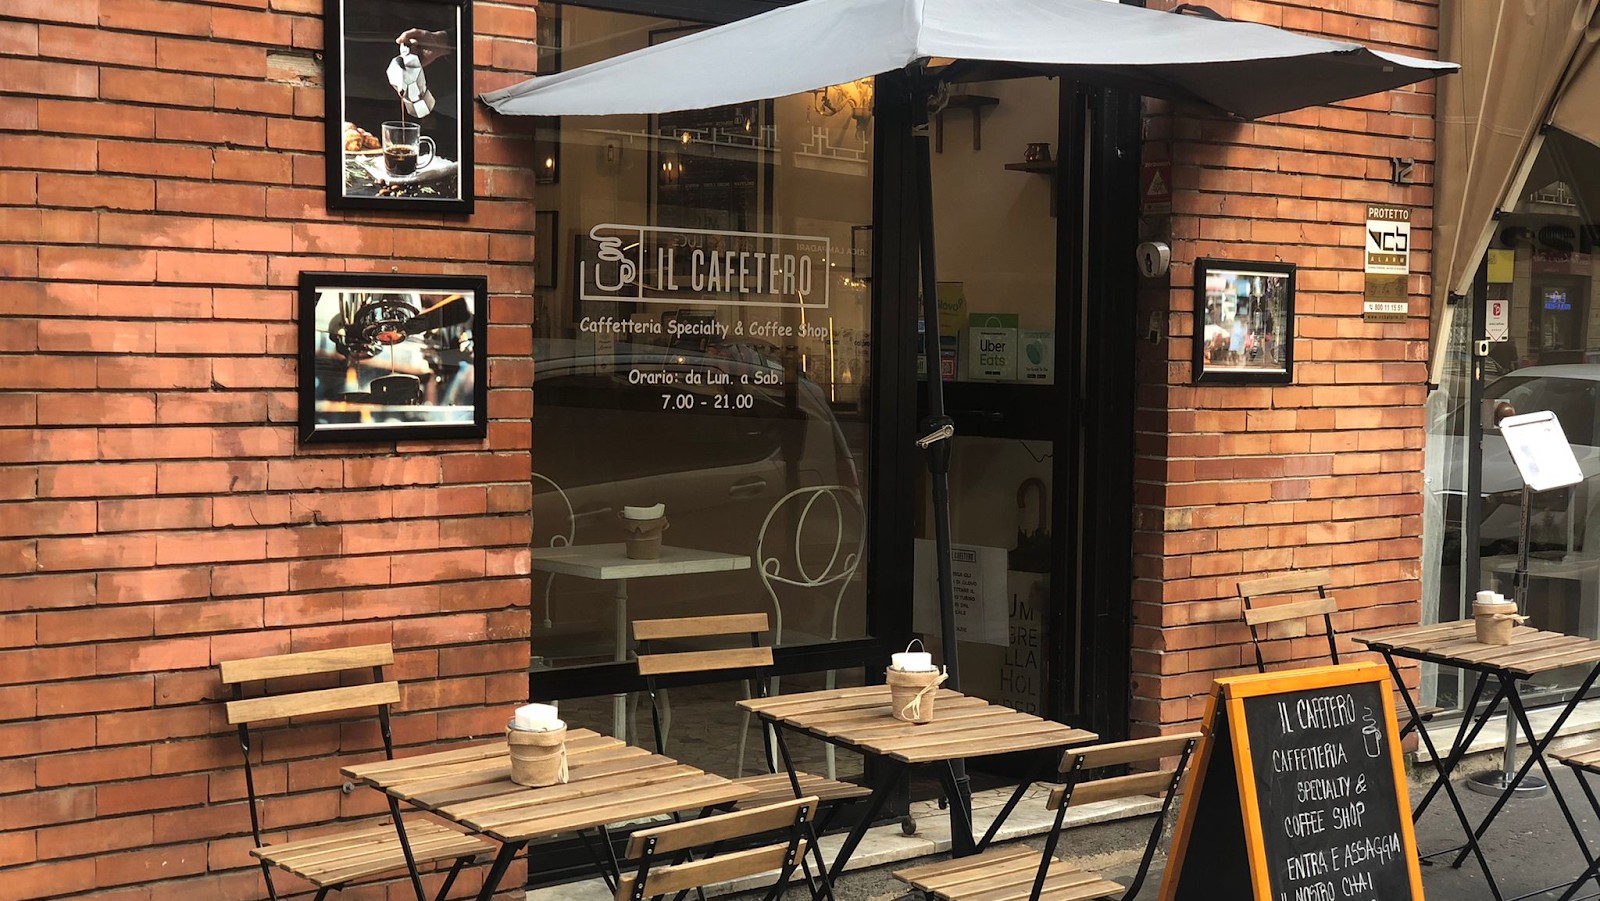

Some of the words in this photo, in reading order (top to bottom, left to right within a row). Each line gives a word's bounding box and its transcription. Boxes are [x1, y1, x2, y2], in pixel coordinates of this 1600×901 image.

[1392, 157, 1415, 185] 12
[1368, 207, 1409, 220] PROTETTO
[657, 247, 679, 291] IL
[692, 249, 812, 296] CAFETERO
[1370, 256, 1405, 265] ALARM
[580, 316, 661, 334] Caffetteria
[667, 319, 729, 339] Specialty
[734, 321, 744, 336] &
[749, 321, 792, 337] Coffee
[798, 323, 828, 341] Shop
[980, 339, 1006, 352] Uber
[980, 354, 1006, 366] Eats
[628, 369, 679, 385] Orario:
[685, 369, 701, 384] da
[707, 370, 734, 385] Lun.
[740, 374, 748, 384] a
[754, 370, 783, 385] Sab.
[661, 394, 694, 410] 7.00
[713, 394, 754, 410] 21.00
[1000, 668, 1036, 696] HOL
[1278, 702, 1294, 734] IL
[1297, 694, 1356, 730] CAFETERO
[1298, 776, 1350, 802] SPECIALTY
[1355, 773, 1367, 794] &
[1284, 810, 1326, 838] COFFEE
[1333, 801, 1365, 830] SHOP
[1286, 850, 1328, 881] ENTRA
[1331, 846, 1340, 872] E
[1344, 832, 1401, 868] ASSAGGIA
[1296, 882, 1335, 901] NOSTRO
[1342, 872, 1373, 896] CHAI
